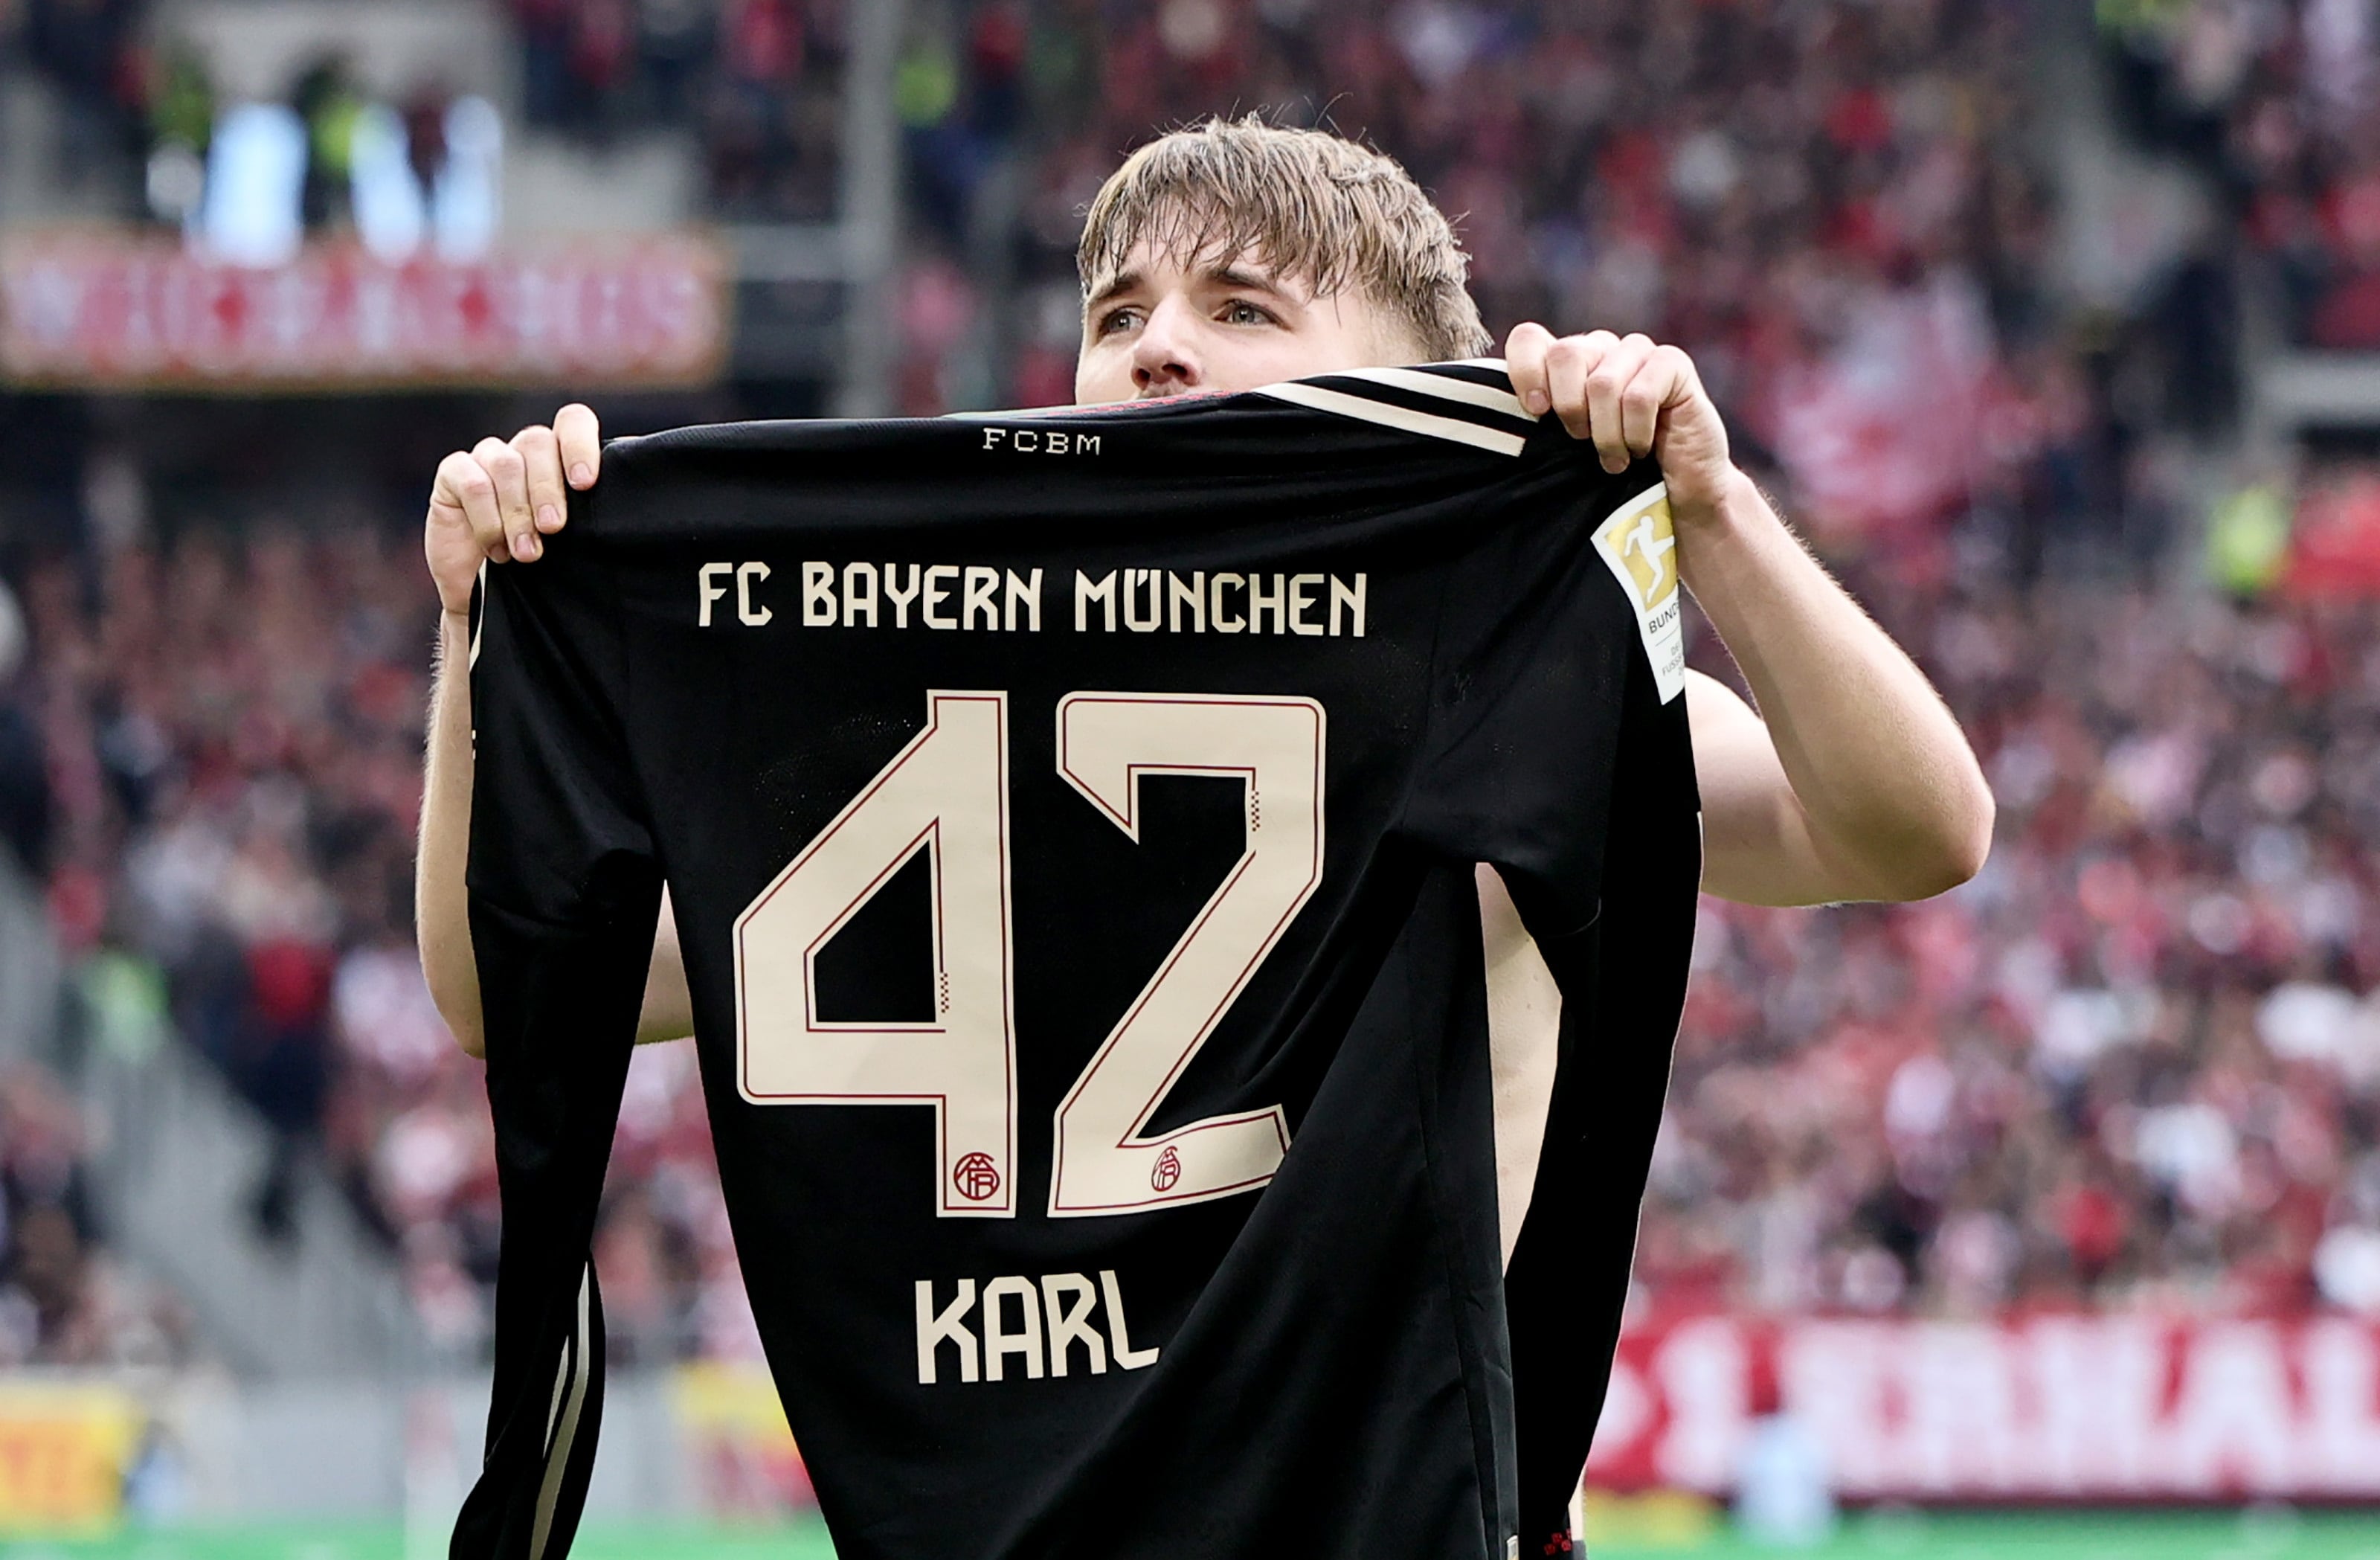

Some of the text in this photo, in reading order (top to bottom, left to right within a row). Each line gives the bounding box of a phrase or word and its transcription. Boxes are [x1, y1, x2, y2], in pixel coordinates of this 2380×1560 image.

[982, 427, 1101, 455] FCBM
[698, 561, 1367, 638] FC BAYERN MÜNCHEN
[732, 689, 1327, 1219] 42
[915, 1269, 1160, 1384] KARL
